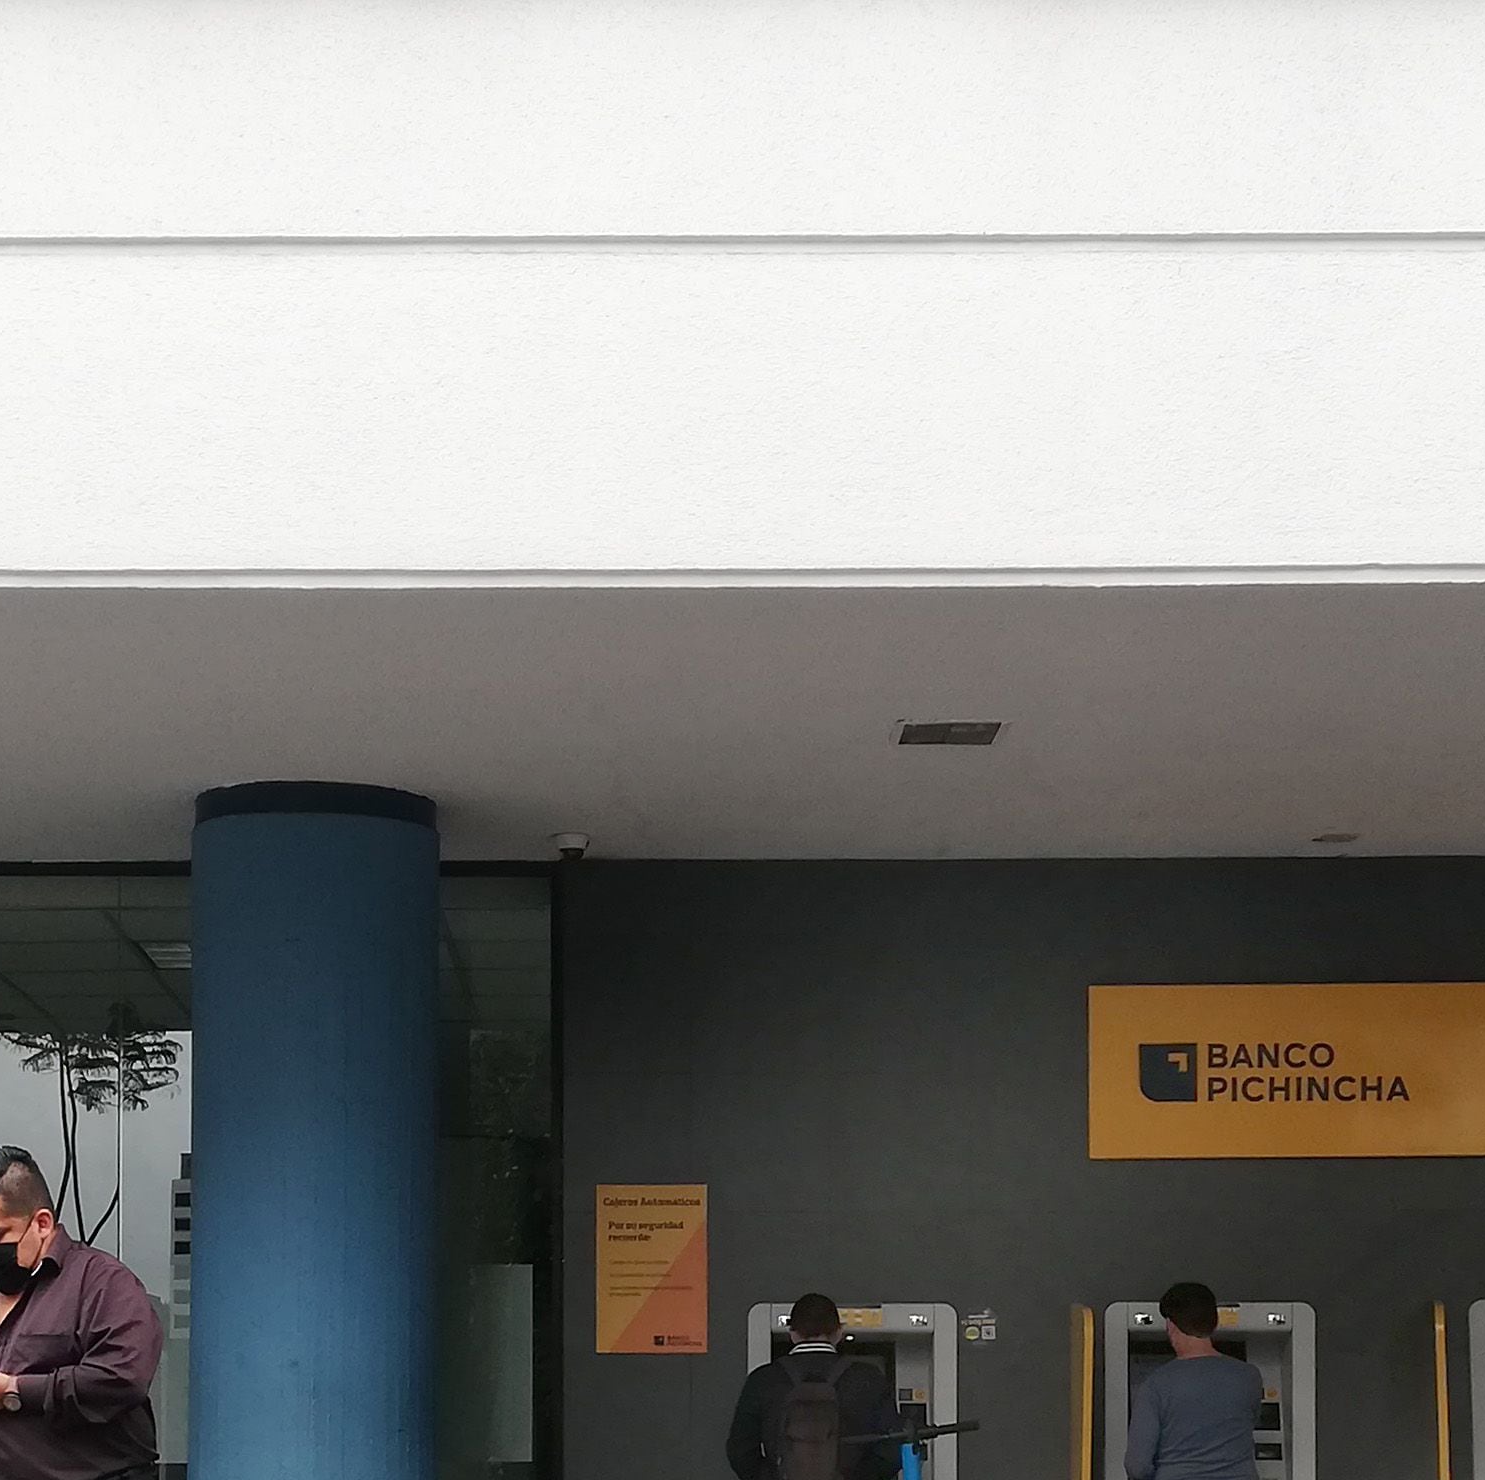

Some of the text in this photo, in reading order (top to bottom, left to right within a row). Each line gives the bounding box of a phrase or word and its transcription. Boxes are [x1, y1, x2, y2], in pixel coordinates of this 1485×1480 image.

[1207, 1042, 1335, 1069] BANCO
[1207, 1075, 1410, 1102] PICHINCHA
[638, 1220, 684, 1232] seguridad
